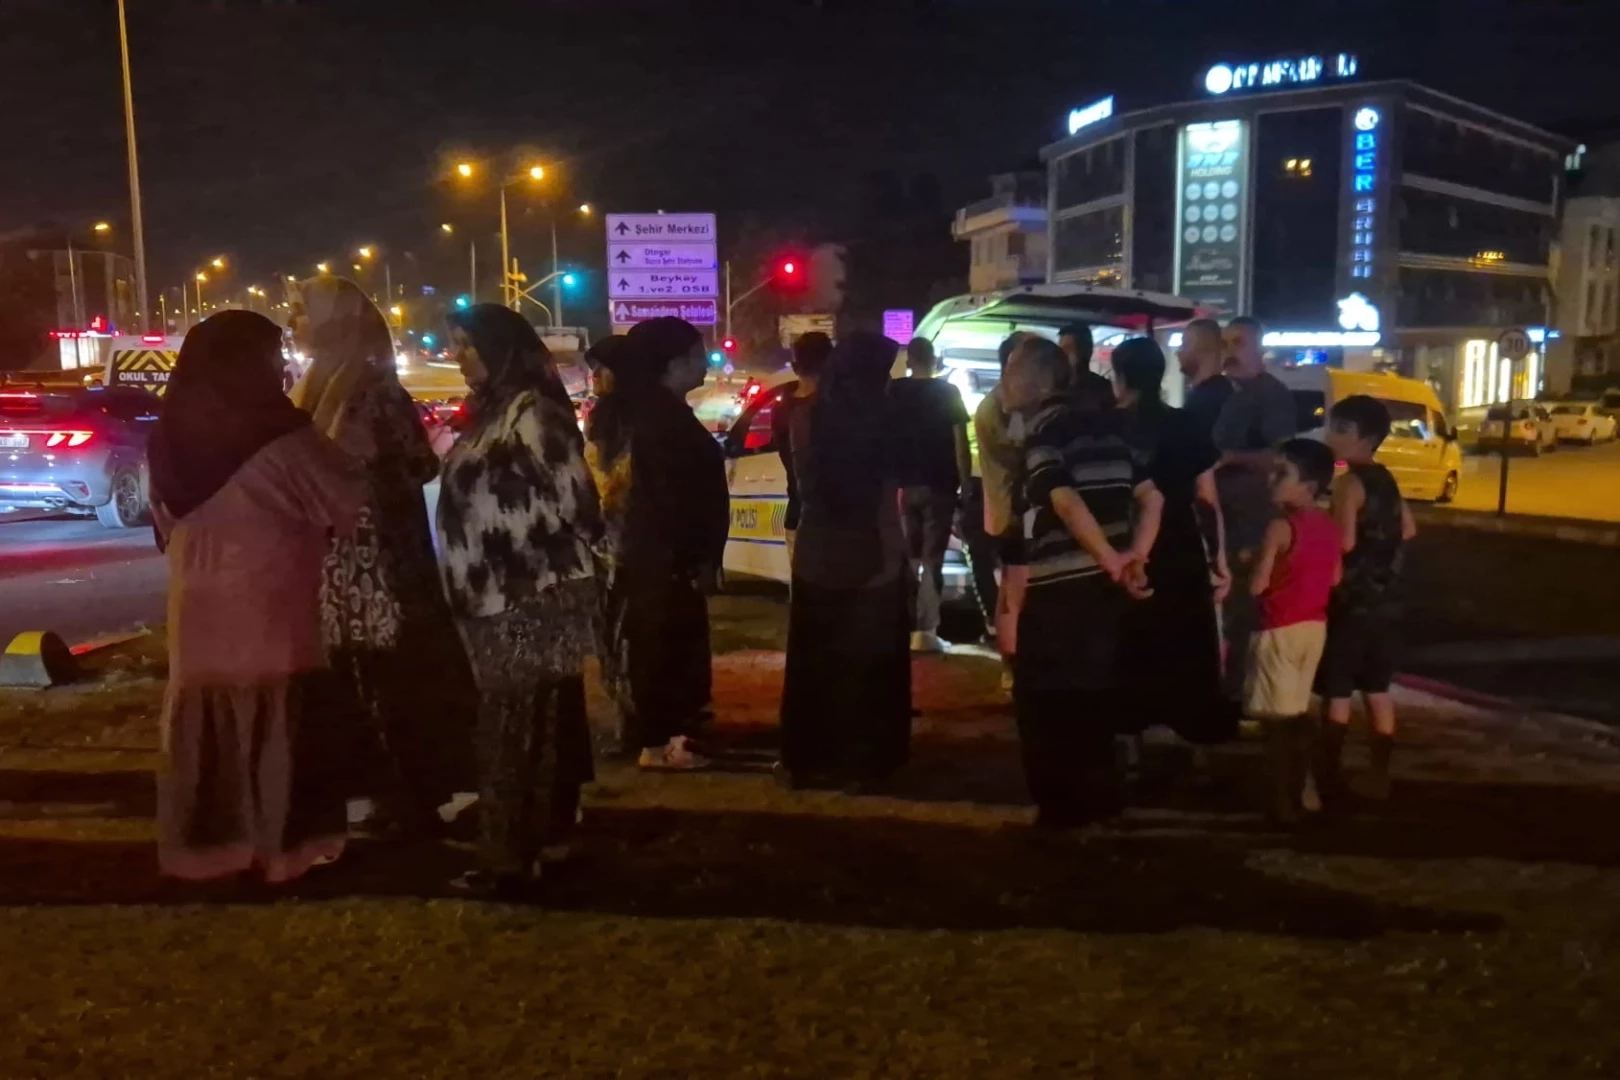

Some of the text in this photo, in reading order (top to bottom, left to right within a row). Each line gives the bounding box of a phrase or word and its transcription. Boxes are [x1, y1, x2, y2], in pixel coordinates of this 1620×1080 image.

[1355, 133, 1375, 191] BER
[635, 223, 709, 235] Şehir Merkezi
[119, 372, 147, 381] OKUL
